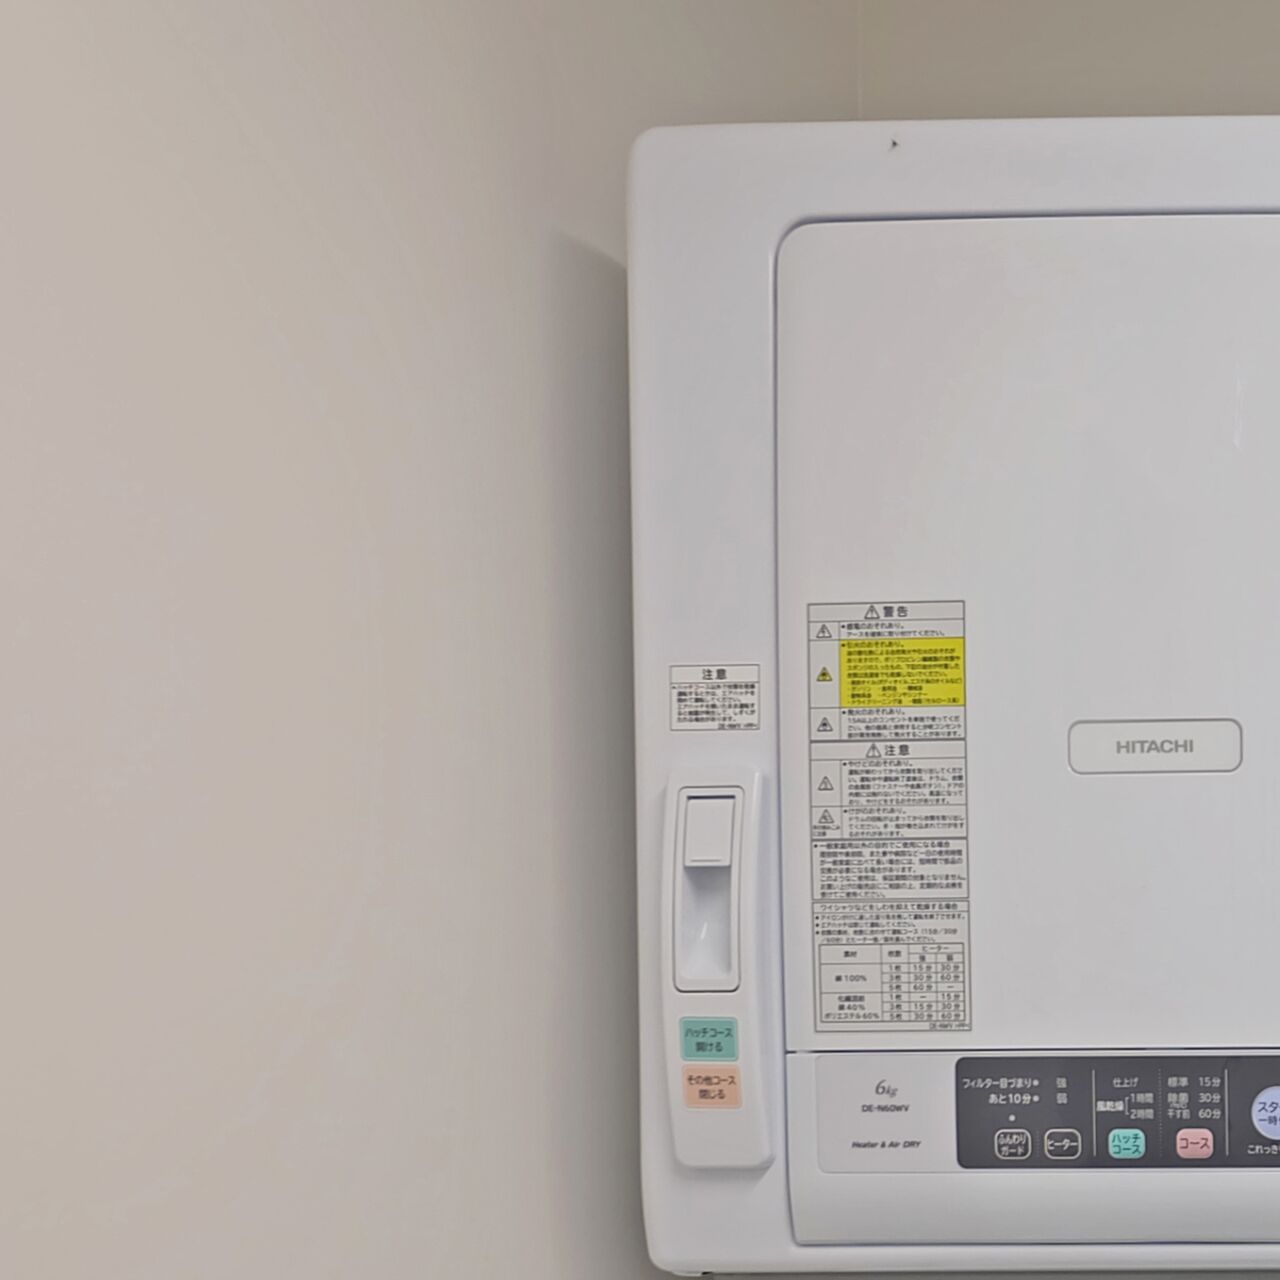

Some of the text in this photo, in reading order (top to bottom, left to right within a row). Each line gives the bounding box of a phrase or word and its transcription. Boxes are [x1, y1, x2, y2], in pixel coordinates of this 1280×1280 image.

[883, 606, 908, 617] 警告
[702, 669, 727, 680] 注意
[884, 745, 910, 756] 注意
[1116, 740, 1194, 753] HITACHI
[685, 1028, 733, 1037] ハッチコース
[696, 1042, 723, 1052] 開ける
[688, 1075, 736, 1085] その他コース
[962, 1078, 1067, 1088] フィルター目づまり 強
[1112, 1078, 1138, 1088] 仕上げ
[1168, 1076, 1221, 1087] 標準 15分
[699, 1090, 725, 1099] 閉じる
[988, 1094, 1067, 1104] あと10分 弱
[1130, 1093, 1154, 1103] 1時間
[1199, 1092, 1221, 1103] 30分
[1130, 1109, 1154, 1120] 2時間
[1199, 1108, 1221, 1119] 60分
[998, 1134, 1027, 1145] ふんわり
[1048, 1138, 1078, 1150] ヒーター
[1112, 1134, 1141, 1144] ハッチ
[1179, 1137, 1210, 1150] コース
[852, 1140, 920, 1149] Heater & Air DRY
[1000, 1146, 1025, 1156] ガード
[1112, 1146, 1142, 1156] コース
